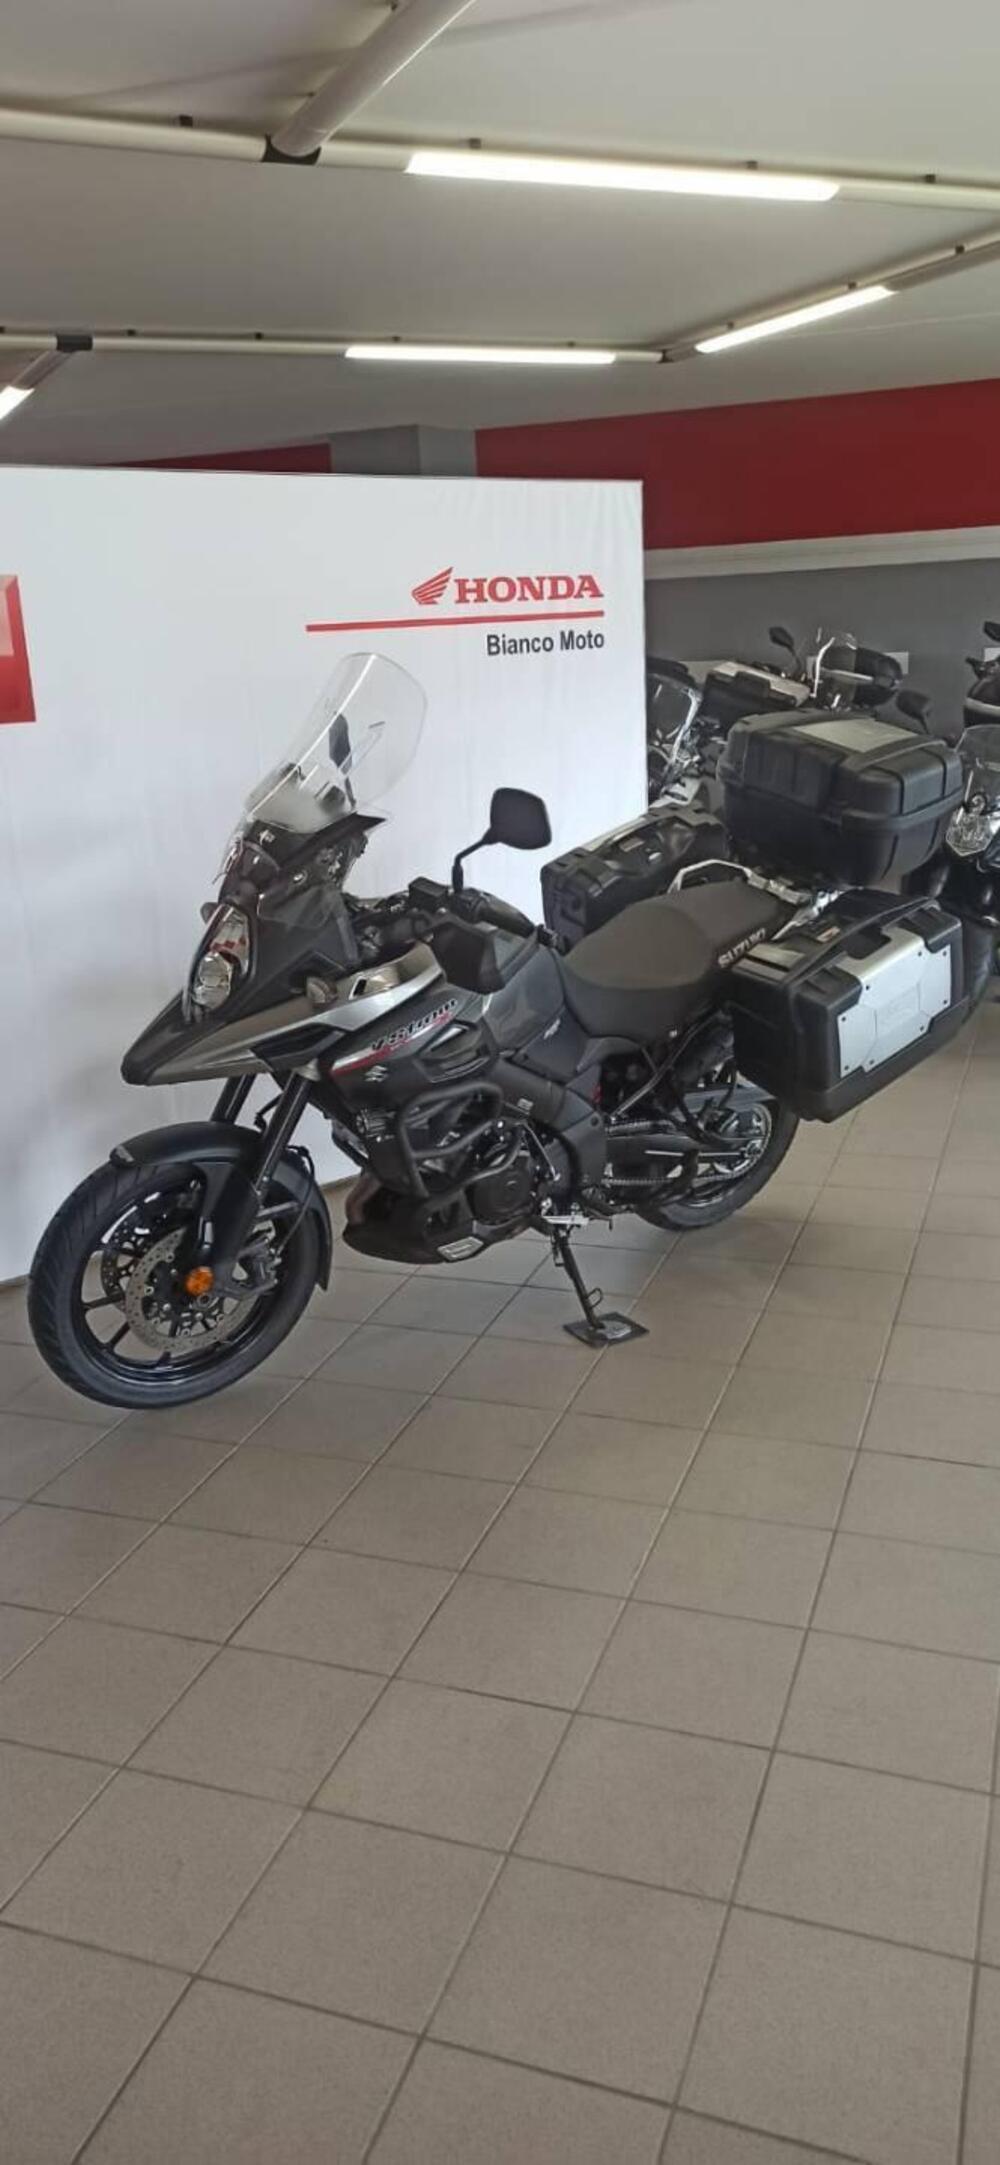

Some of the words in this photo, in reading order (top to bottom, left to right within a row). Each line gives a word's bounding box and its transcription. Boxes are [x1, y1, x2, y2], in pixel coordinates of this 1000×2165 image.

[454, 575, 604, 603] HONDA
[486, 633, 554, 656] Bianco
[559, 629, 605, 651] Moto
